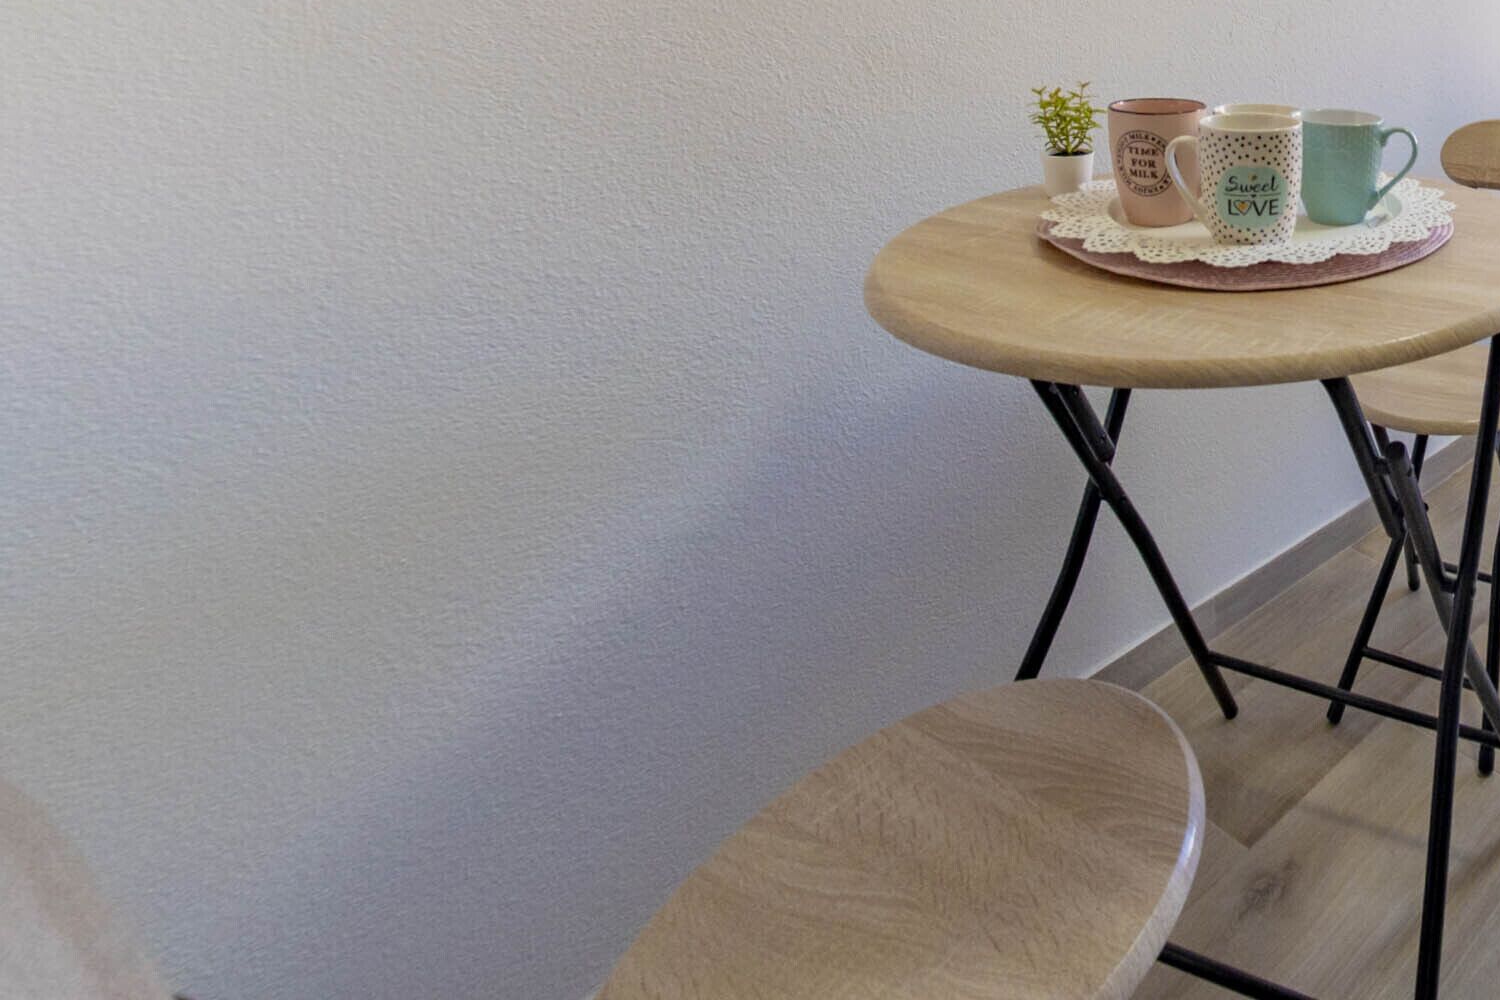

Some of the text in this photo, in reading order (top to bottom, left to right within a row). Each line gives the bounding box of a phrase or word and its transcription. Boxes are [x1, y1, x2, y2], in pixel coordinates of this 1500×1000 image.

[1129, 147, 1159, 156] TIME
[1131, 158, 1156, 168] FOR
[1129, 169, 1158, 179] MILK
[1225, 174, 1280, 193] Sweet
[1227, 199, 1279, 217] LOVE
